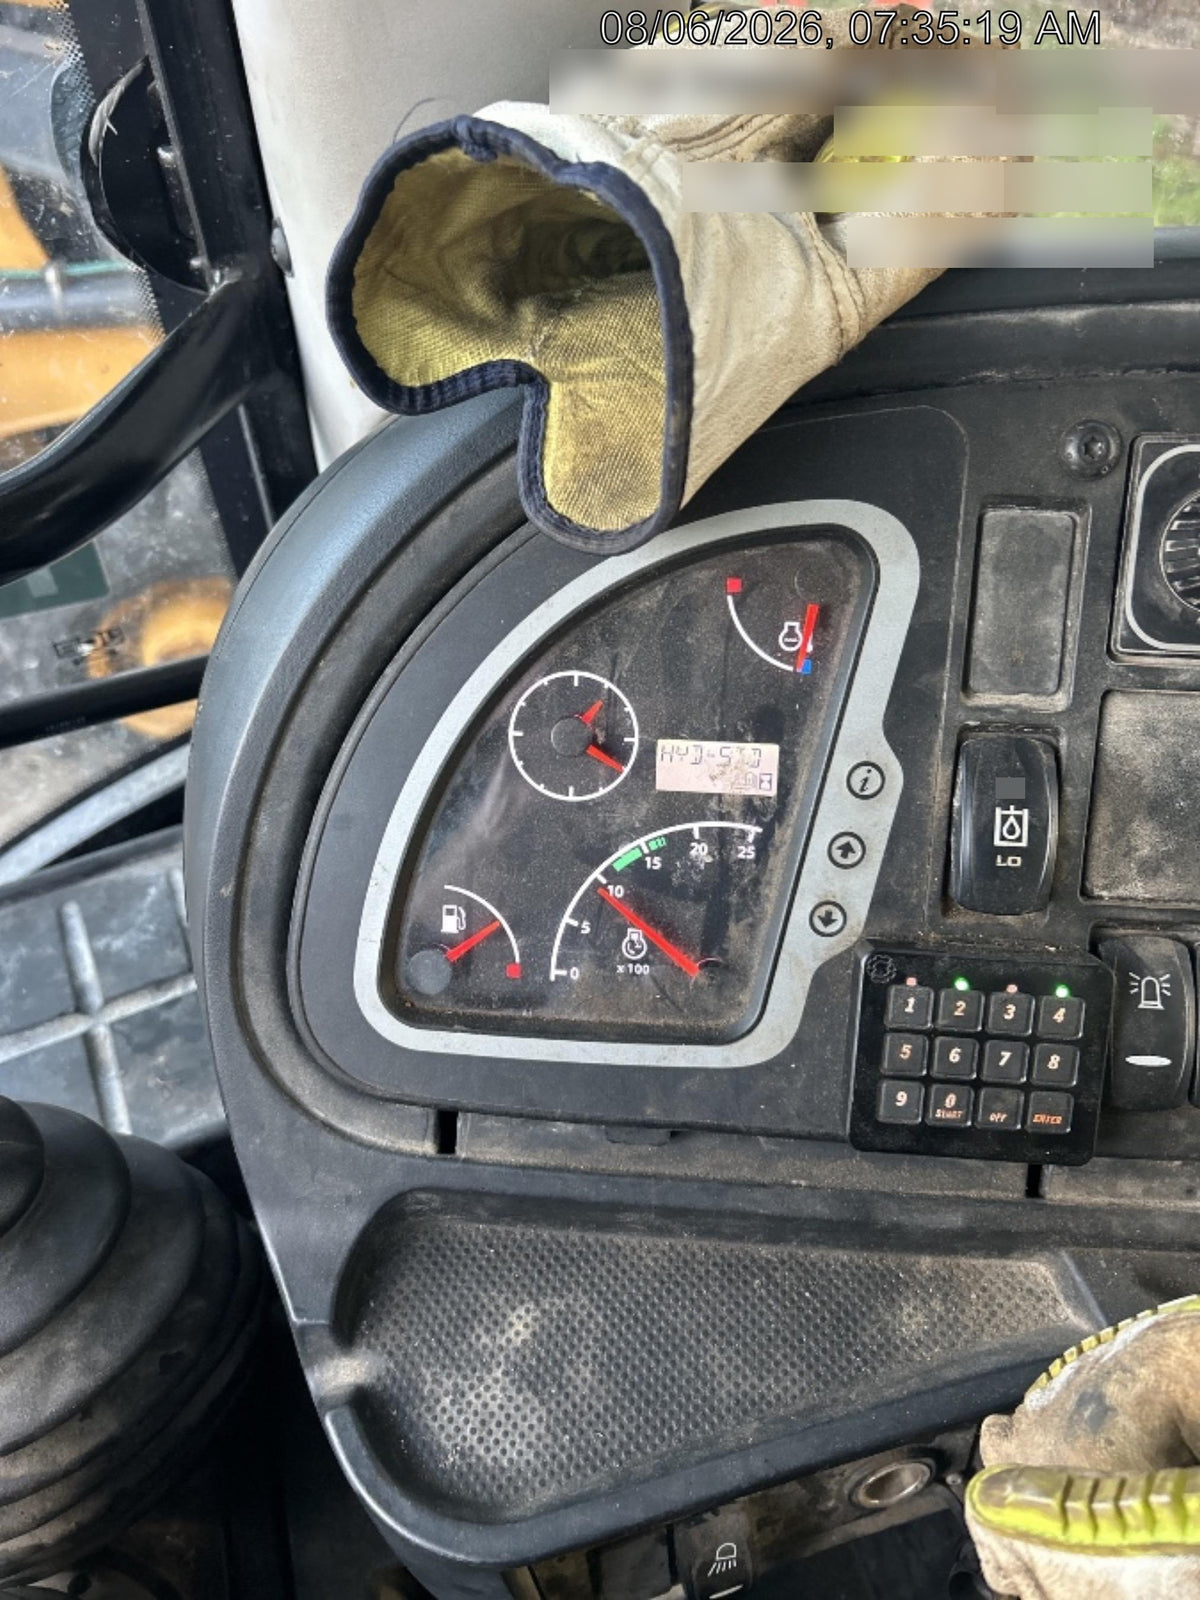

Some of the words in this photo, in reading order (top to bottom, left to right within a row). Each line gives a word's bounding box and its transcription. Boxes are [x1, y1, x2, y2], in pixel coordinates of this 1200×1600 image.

[690, 843, 708, 856] 20
[737, 846, 756, 859] 25
[645, 857, 662, 870] 15
[995, 854, 1021, 867] LO
[607, 885, 624, 898] 10
[580, 921, 591, 934] 5
[569, 967, 580, 979] 0
[628, 964, 649, 974] 100
[904, 997, 916, 1013] 1
[954, 1001, 967, 1016] 2
[1003, 1004, 1016, 1020] 3
[1053, 1007, 1066, 1023] 4
[900, 1044, 913, 1059] 5
[949, 1048, 961, 1063] 6
[999, 1051, 1012, 1066] 7
[1047, 1054, 1060, 1070] 8
[895, 1091, 908, 1106] 9
[944, 1093, 957, 1108] 0
[935, 1109, 963, 1119] START
[1032, 1113, 1063, 1125] ENTER
